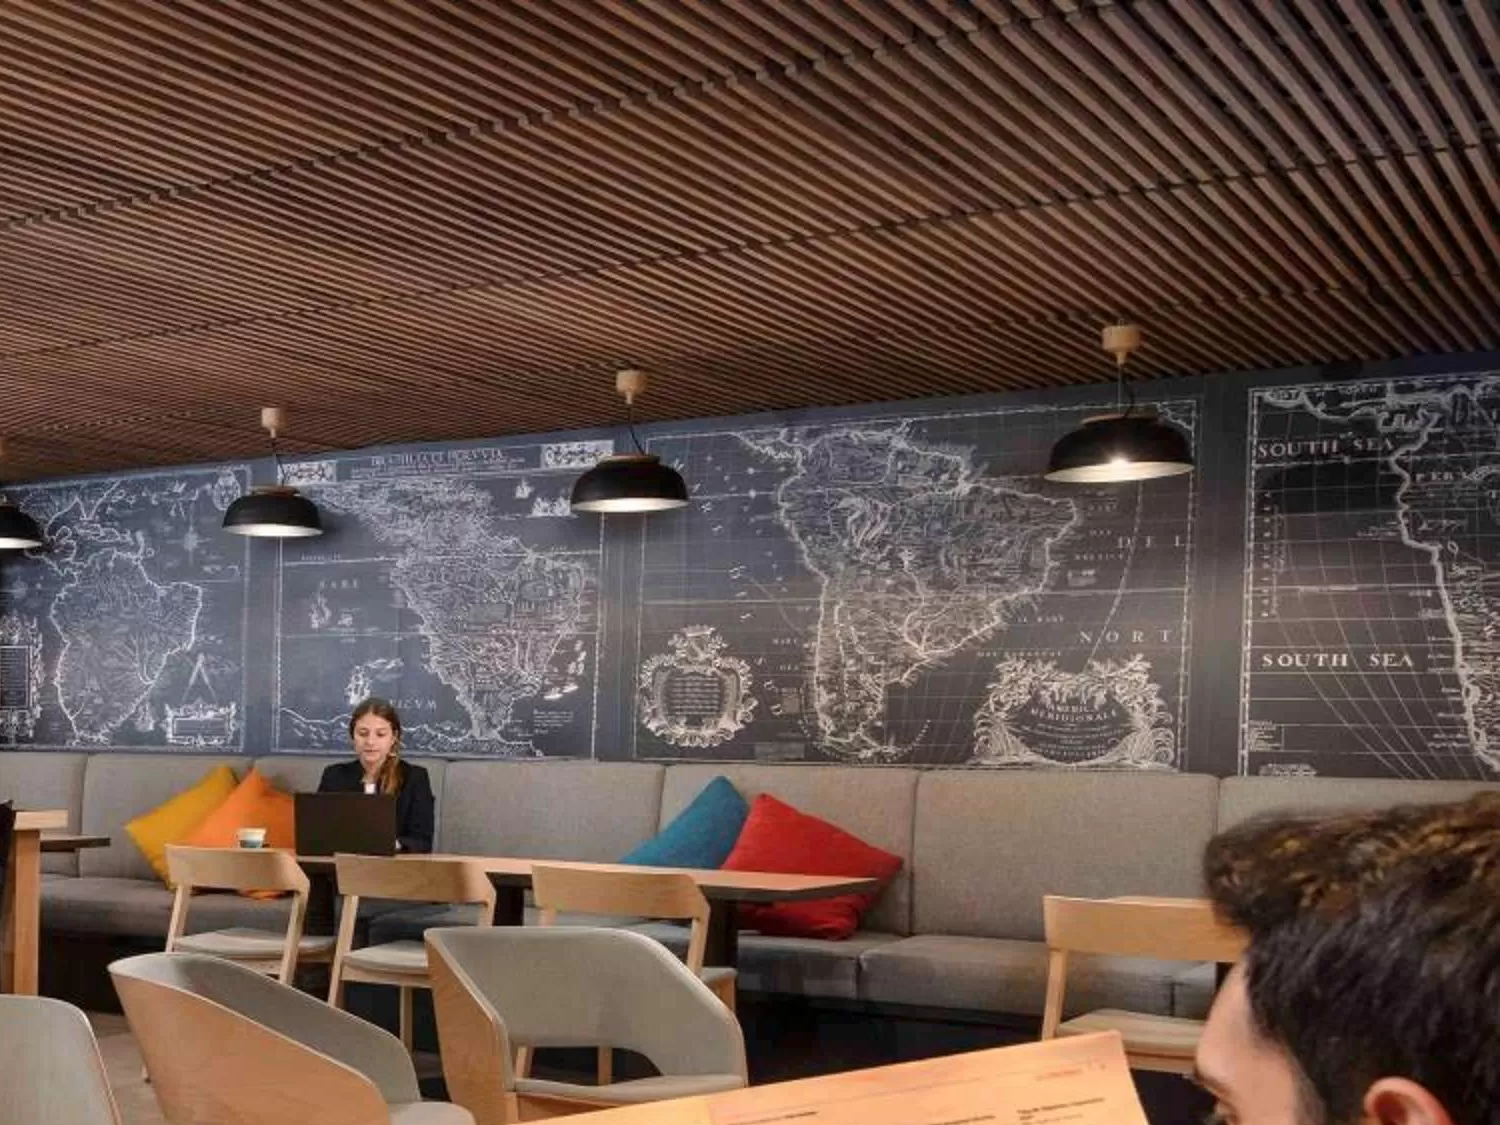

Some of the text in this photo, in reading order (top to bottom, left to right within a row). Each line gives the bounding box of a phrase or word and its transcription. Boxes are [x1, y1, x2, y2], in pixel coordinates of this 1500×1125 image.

[1258, 438, 1394, 457] SOUTH SEA
[1262, 653, 1413, 667] SOUTH SEA
